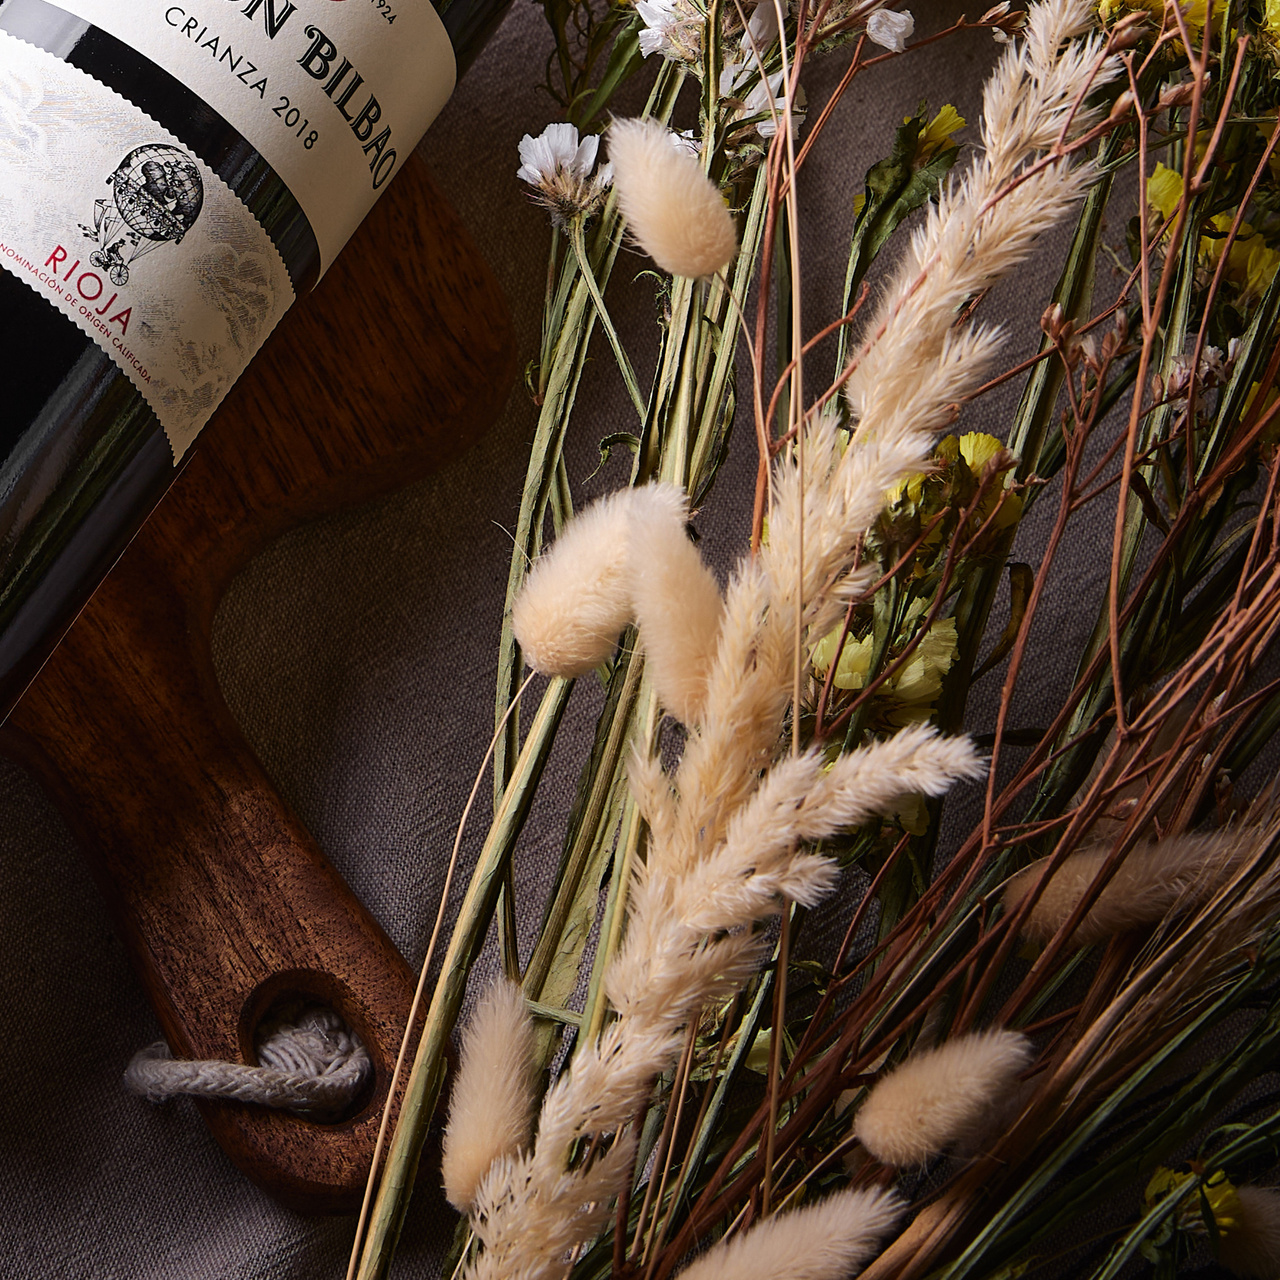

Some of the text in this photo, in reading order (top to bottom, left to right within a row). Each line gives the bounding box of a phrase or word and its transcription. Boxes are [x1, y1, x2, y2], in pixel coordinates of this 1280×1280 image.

[164, 5, 320, 151] CRIANZA 2018
[296, 23, 398, 191] BILBAO
[43, 244, 134, 336] RIOJA
[64, 293, 78, 308] DE
[78, 305, 113, 339] ORIGEN
[112, 337, 152, 385] CALIFICADA
